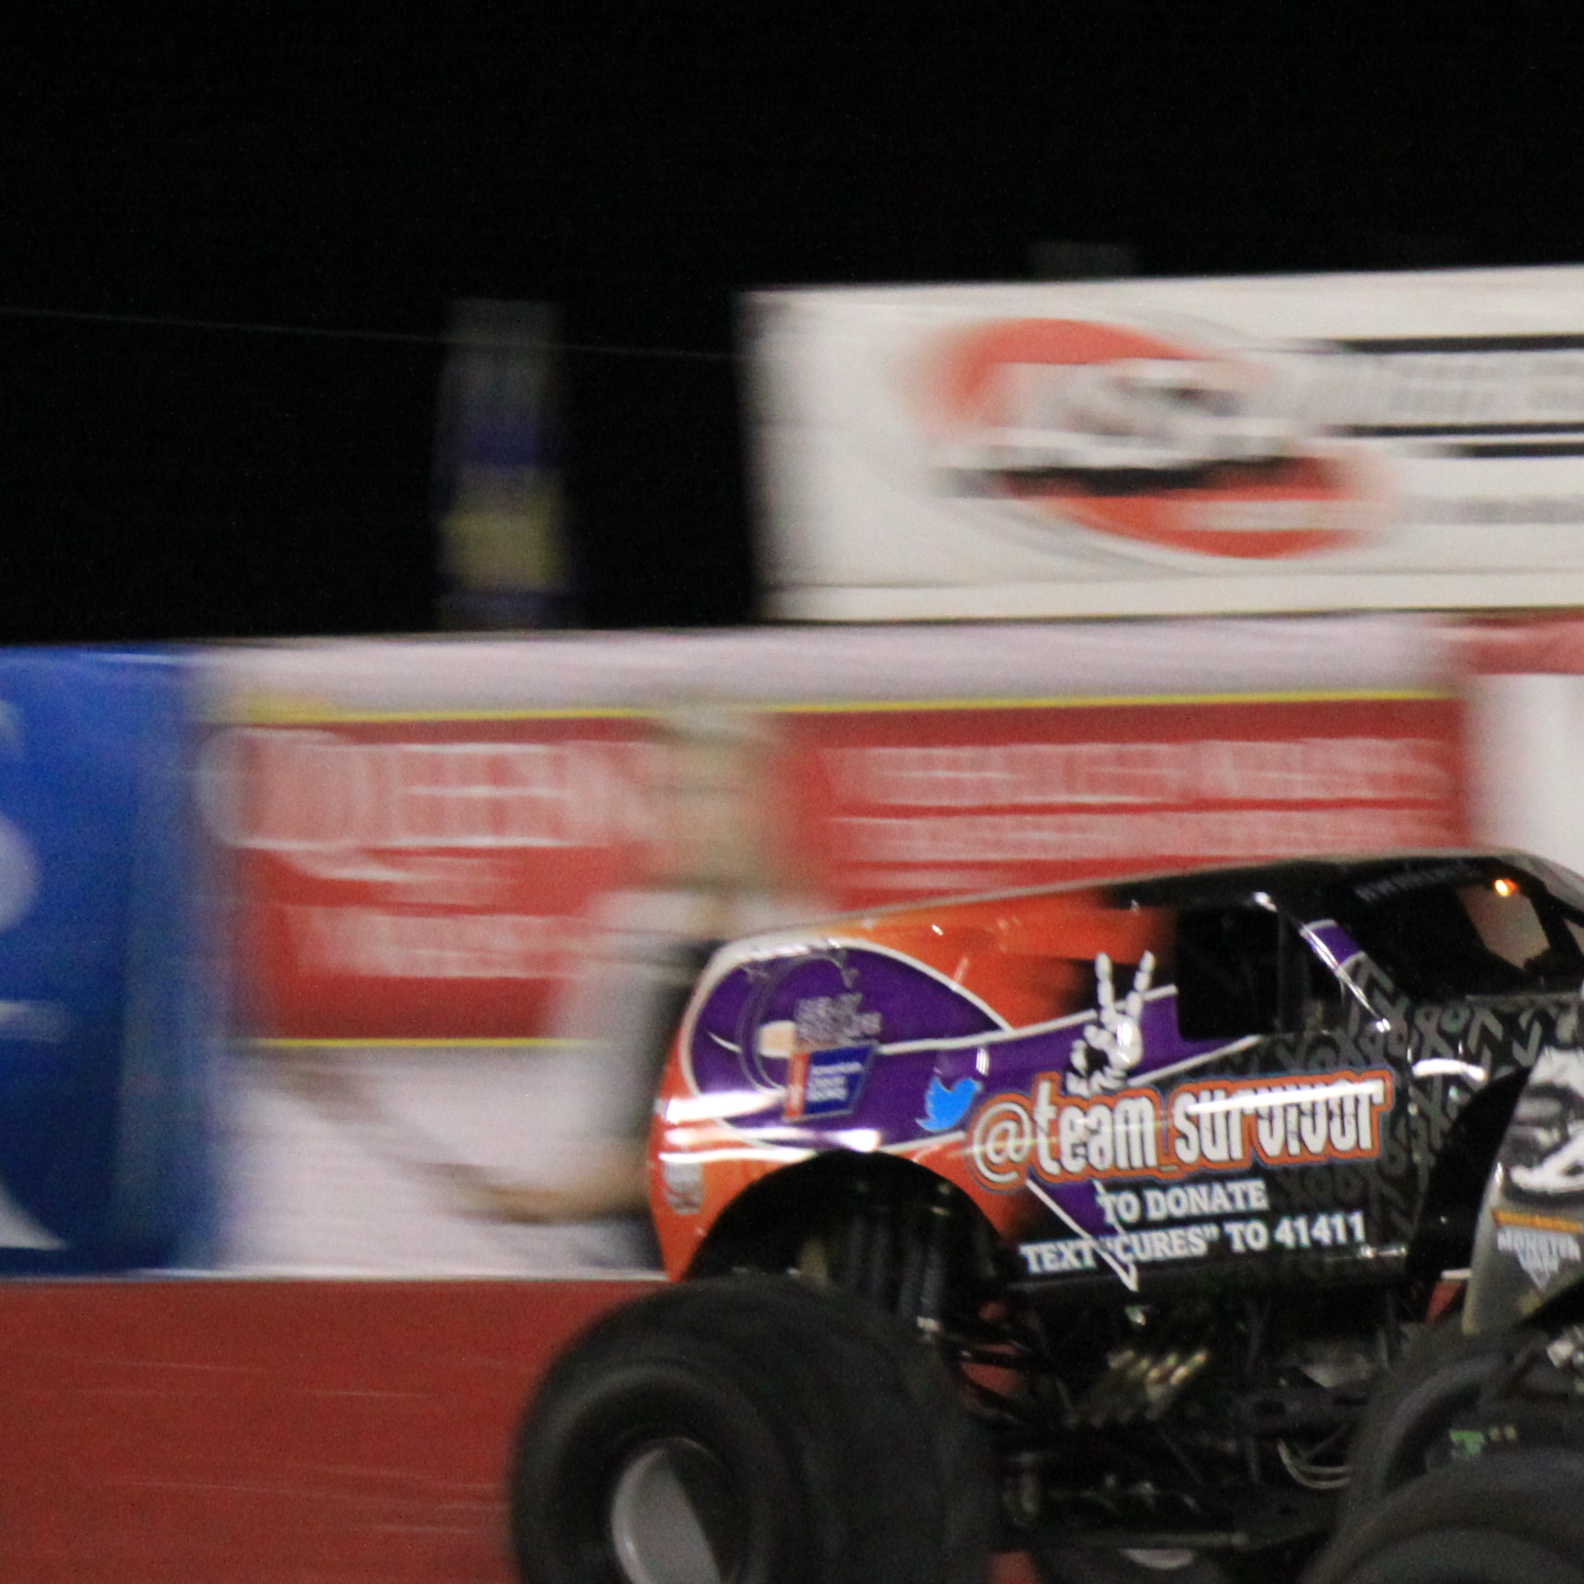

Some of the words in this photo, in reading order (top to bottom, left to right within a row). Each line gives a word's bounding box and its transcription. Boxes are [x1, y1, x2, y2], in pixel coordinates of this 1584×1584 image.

[973, 1077, 1384, 1183] @team_survivor
[1098, 1192, 1140, 1224] TO
[1146, 1180, 1270, 1222] DONATE
[1019, 1241, 1098, 1274] TEXT
[1219, 1221, 1269, 1253] TO
[1275, 1211, 1366, 1247] 41411
